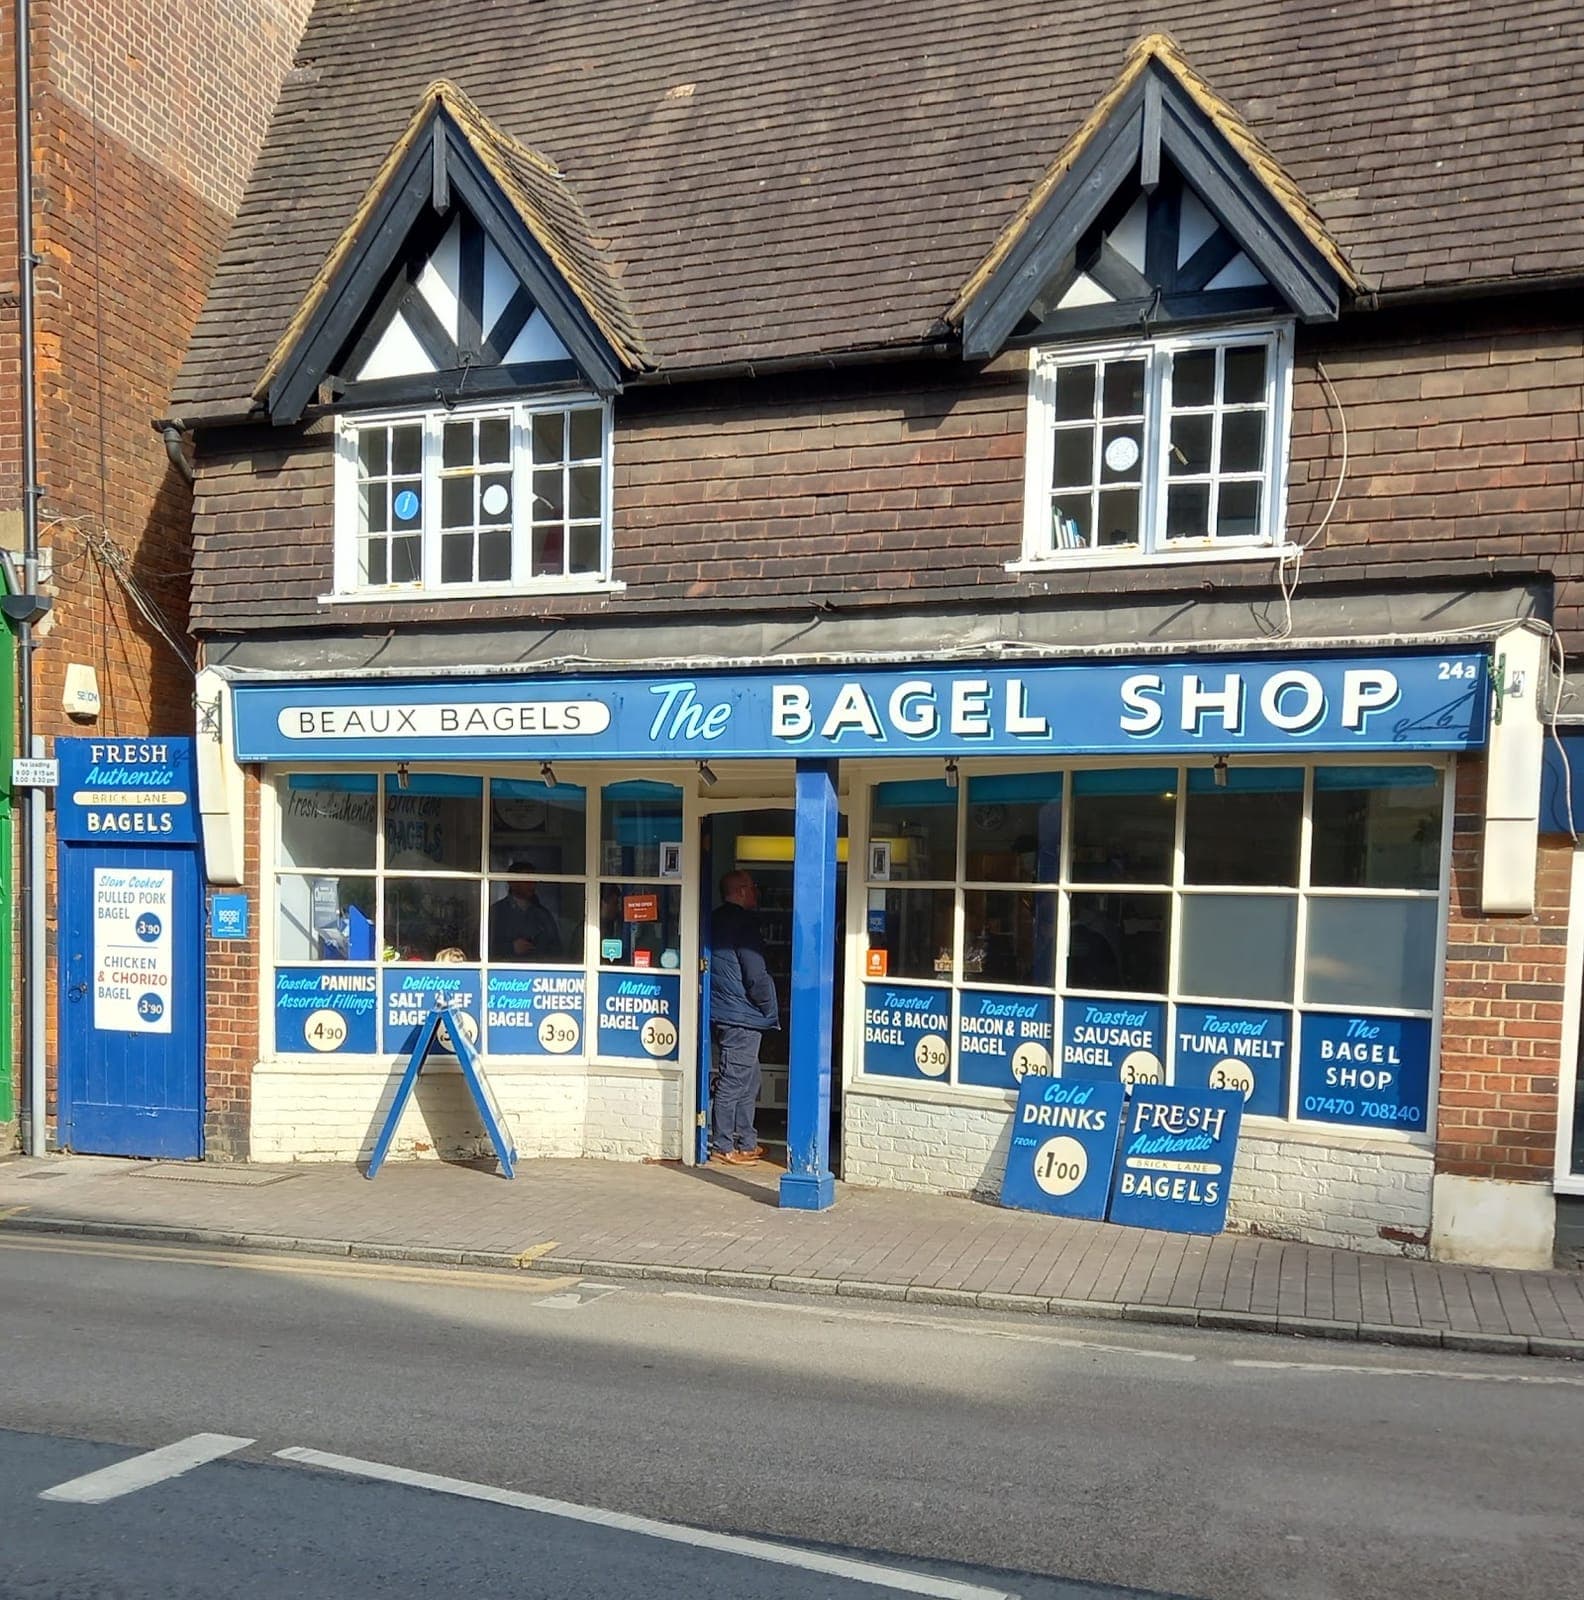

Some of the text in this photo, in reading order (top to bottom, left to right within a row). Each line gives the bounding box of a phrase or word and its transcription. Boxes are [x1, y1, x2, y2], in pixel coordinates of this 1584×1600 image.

[1438, 662, 1476, 680] 24a
[649, 669, 1402, 744] The BAGEL SHOP
[299, 706, 582, 733] BEAUX BAGELS
[90, 744, 168, 764] FRESH
[85, 765, 173, 785] Authentic
[92, 793, 168, 803] BRICK LANE
[88, 812, 173, 834] BAGELS
[99, 875, 165, 889] Slow Cooked
[98, 891, 166, 904] PULLED PORK
[98, 907, 130, 919] BAGEL
[104, 956, 157, 969] CHICKEN
[97, 971, 168, 986] & CHORIZO
[277, 974, 375, 992] Toasted PANINIS
[402, 976, 461, 991] Delicious
[488, 977, 584, 993] Smoked SALMON
[617, 980, 661, 996] Mature
[98, 986, 131, 1000] BAGEL
[389, 992, 425, 1008] SALT
[487, 995, 582, 1010] & Cream CHEESE
[884, 992, 934, 1010] Toasted
[277, 993, 375, 1015] Assorted Fillings
[605, 997, 669, 1014] CHEDDAR
[979, 999, 1038, 1018] Toasted
[389, 1010, 430, 1026] BAGE
[488, 1011, 533, 1027] BAGEL
[600, 1014, 639, 1031] BAGEL
[865, 1009, 948, 1031] EGG & BACON
[1084, 1006, 1148, 1027] Toasted
[1202, 1015, 1268, 1036] Toasted
[865, 1027, 905, 1045] BAGEL
[960, 1016, 1052, 1039] BACON & BRIE
[1073, 1026, 1152, 1048] SAUSAGE
[1346, 1018, 1380, 1039] The
[961, 1035, 1006, 1056] BAGEL
[1179, 1034, 1285, 1059] TUNA MELT
[1321, 1040, 1401, 1065] BAGEL
[1064, 1046, 1112, 1066] BAGEL
[1325, 1067, 1393, 1091] SHOP
[1044, 1083, 1094, 1105] Cold
[1022, 1104, 1107, 1131] DRINKS
[1305, 1096, 1420, 1121] 07470 708240
[1133, 1102, 1226, 1141] FRESH
[1013, 1136, 1037, 1147] FROM
[1128, 1134, 1213, 1154] Authentic
[1136, 1160, 1209, 1172] BRICK LANE
[1121, 1173, 1220, 1206] BAGELS
